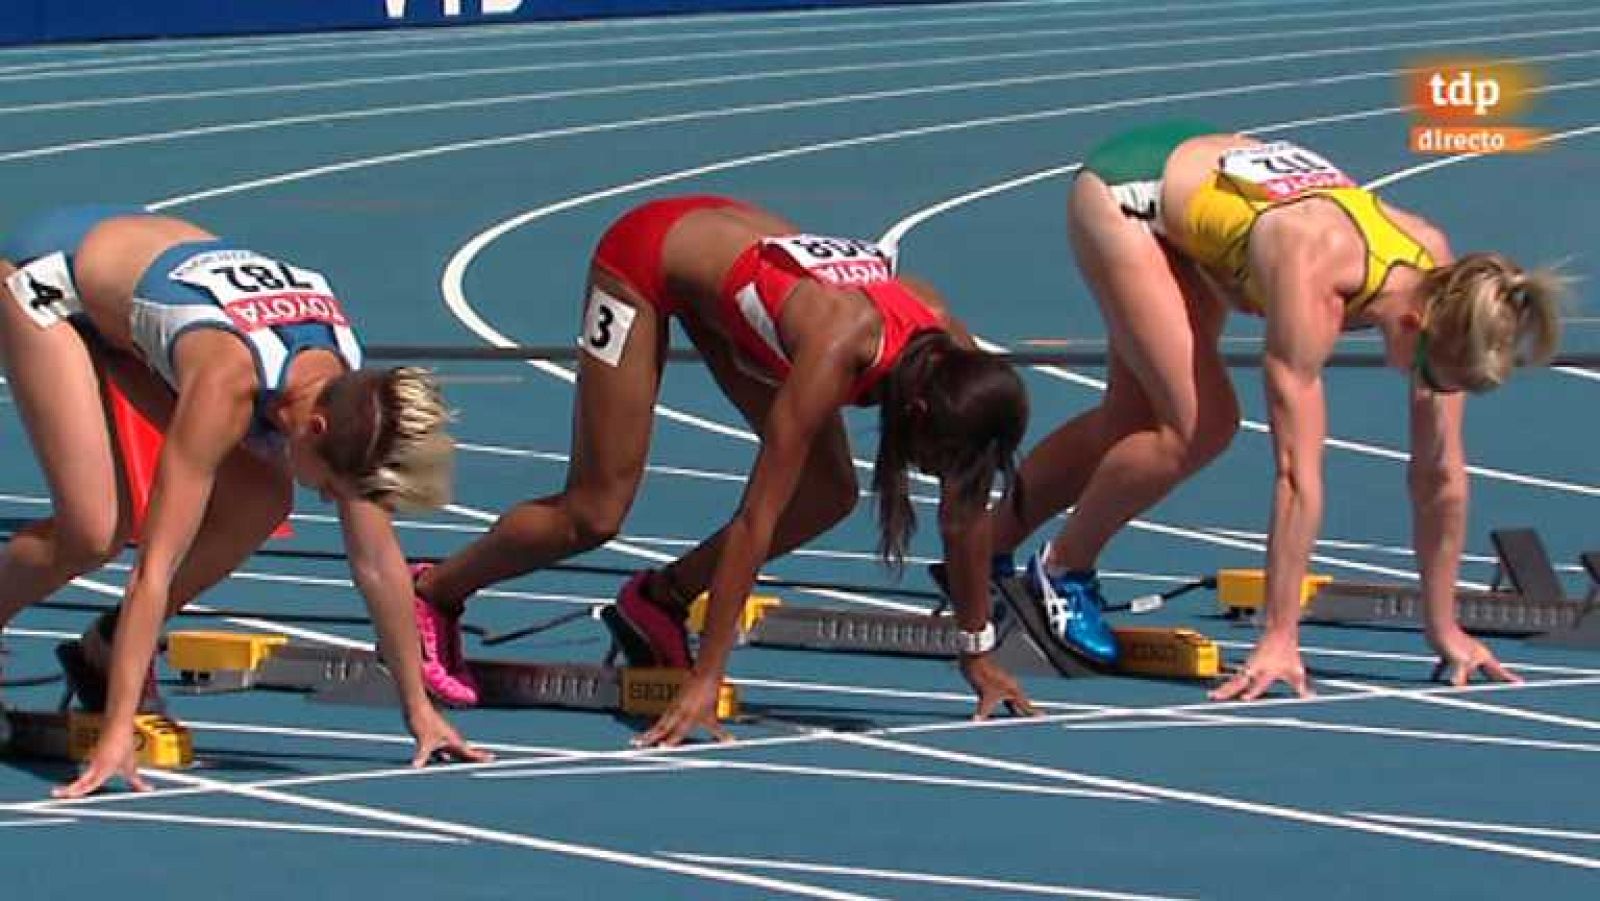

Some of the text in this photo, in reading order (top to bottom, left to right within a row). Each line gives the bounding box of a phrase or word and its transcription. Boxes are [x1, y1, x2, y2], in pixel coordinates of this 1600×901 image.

[26, 270, 63, 310] 4
[210, 261, 314, 293] 782
[231, 296, 347, 333] TOYOTA
[590, 304, 614, 348] 3
[628, 681, 681, 701] SEIK
